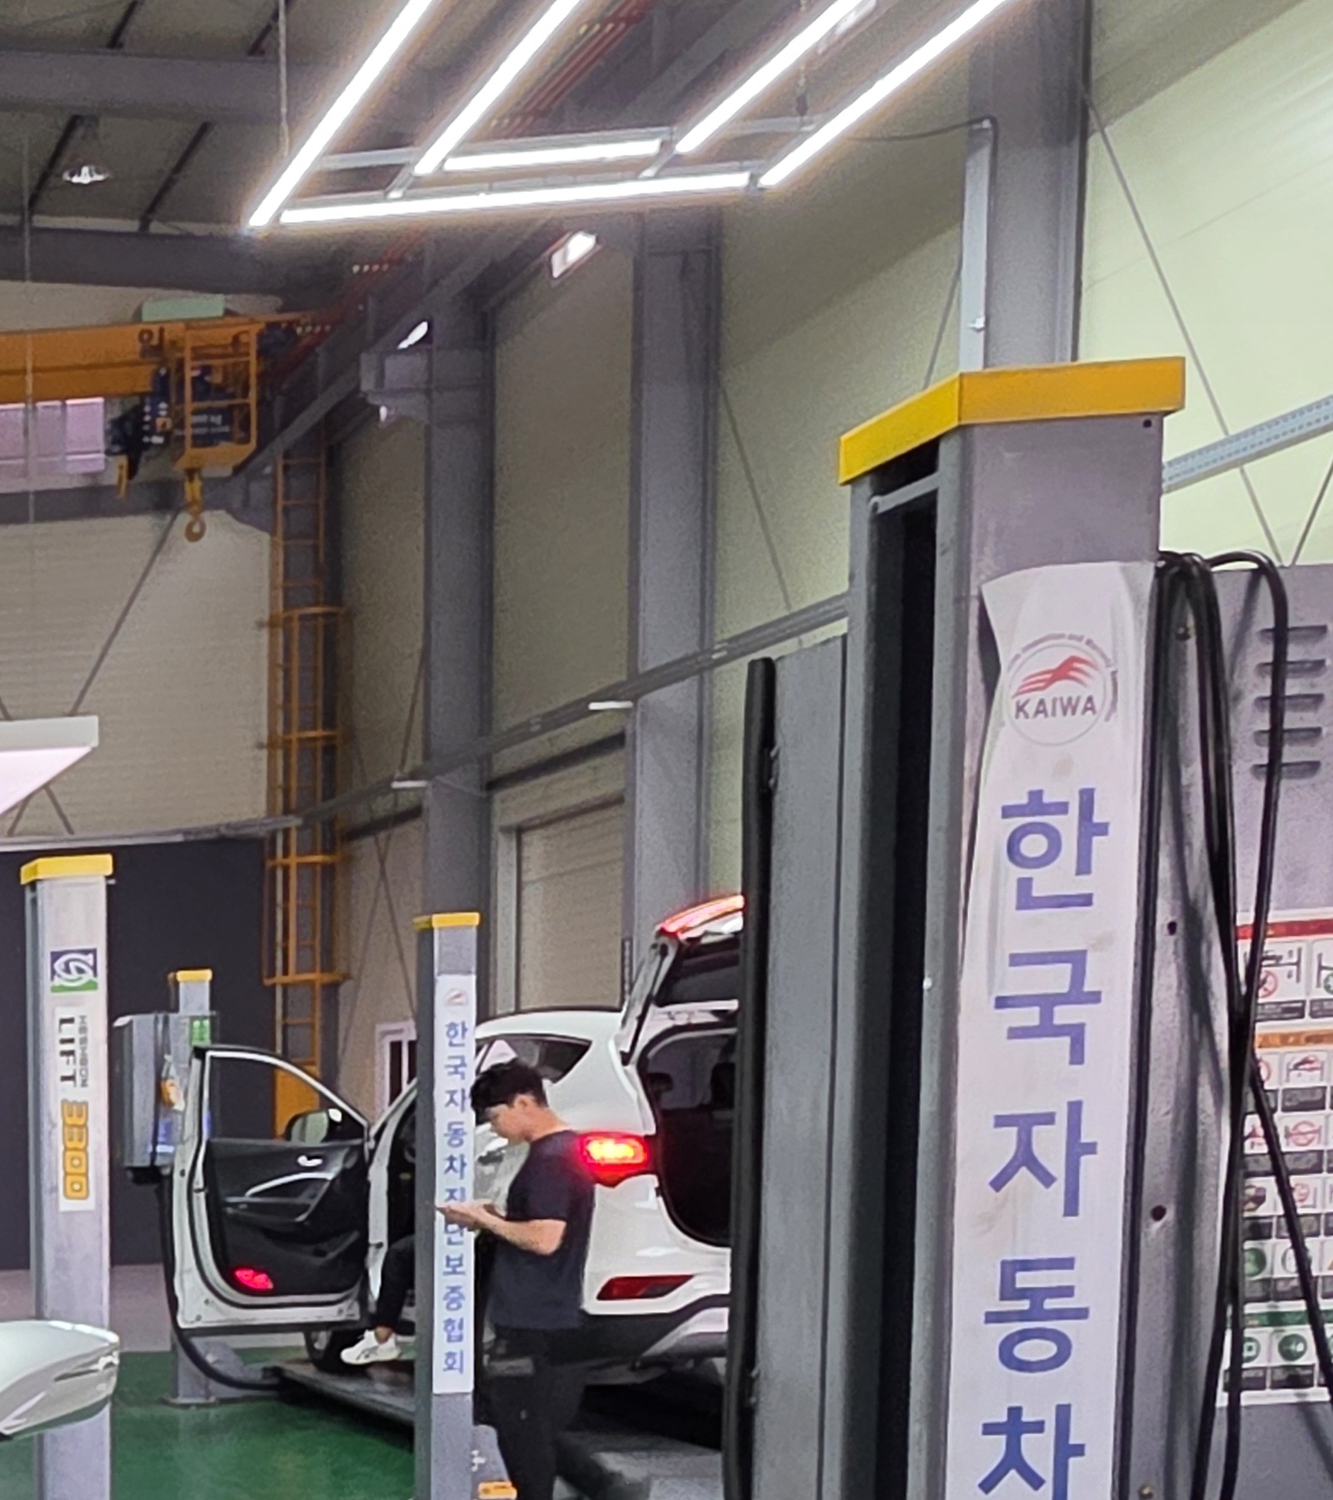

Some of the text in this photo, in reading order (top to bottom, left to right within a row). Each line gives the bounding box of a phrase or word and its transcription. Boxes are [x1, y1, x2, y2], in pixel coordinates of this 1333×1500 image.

[1014, 694, 1097, 719] KAIWA
[58, 1016, 77, 1088] LIFT
[442, 1020, 468, 1375] 한국자동차진단보증협회
